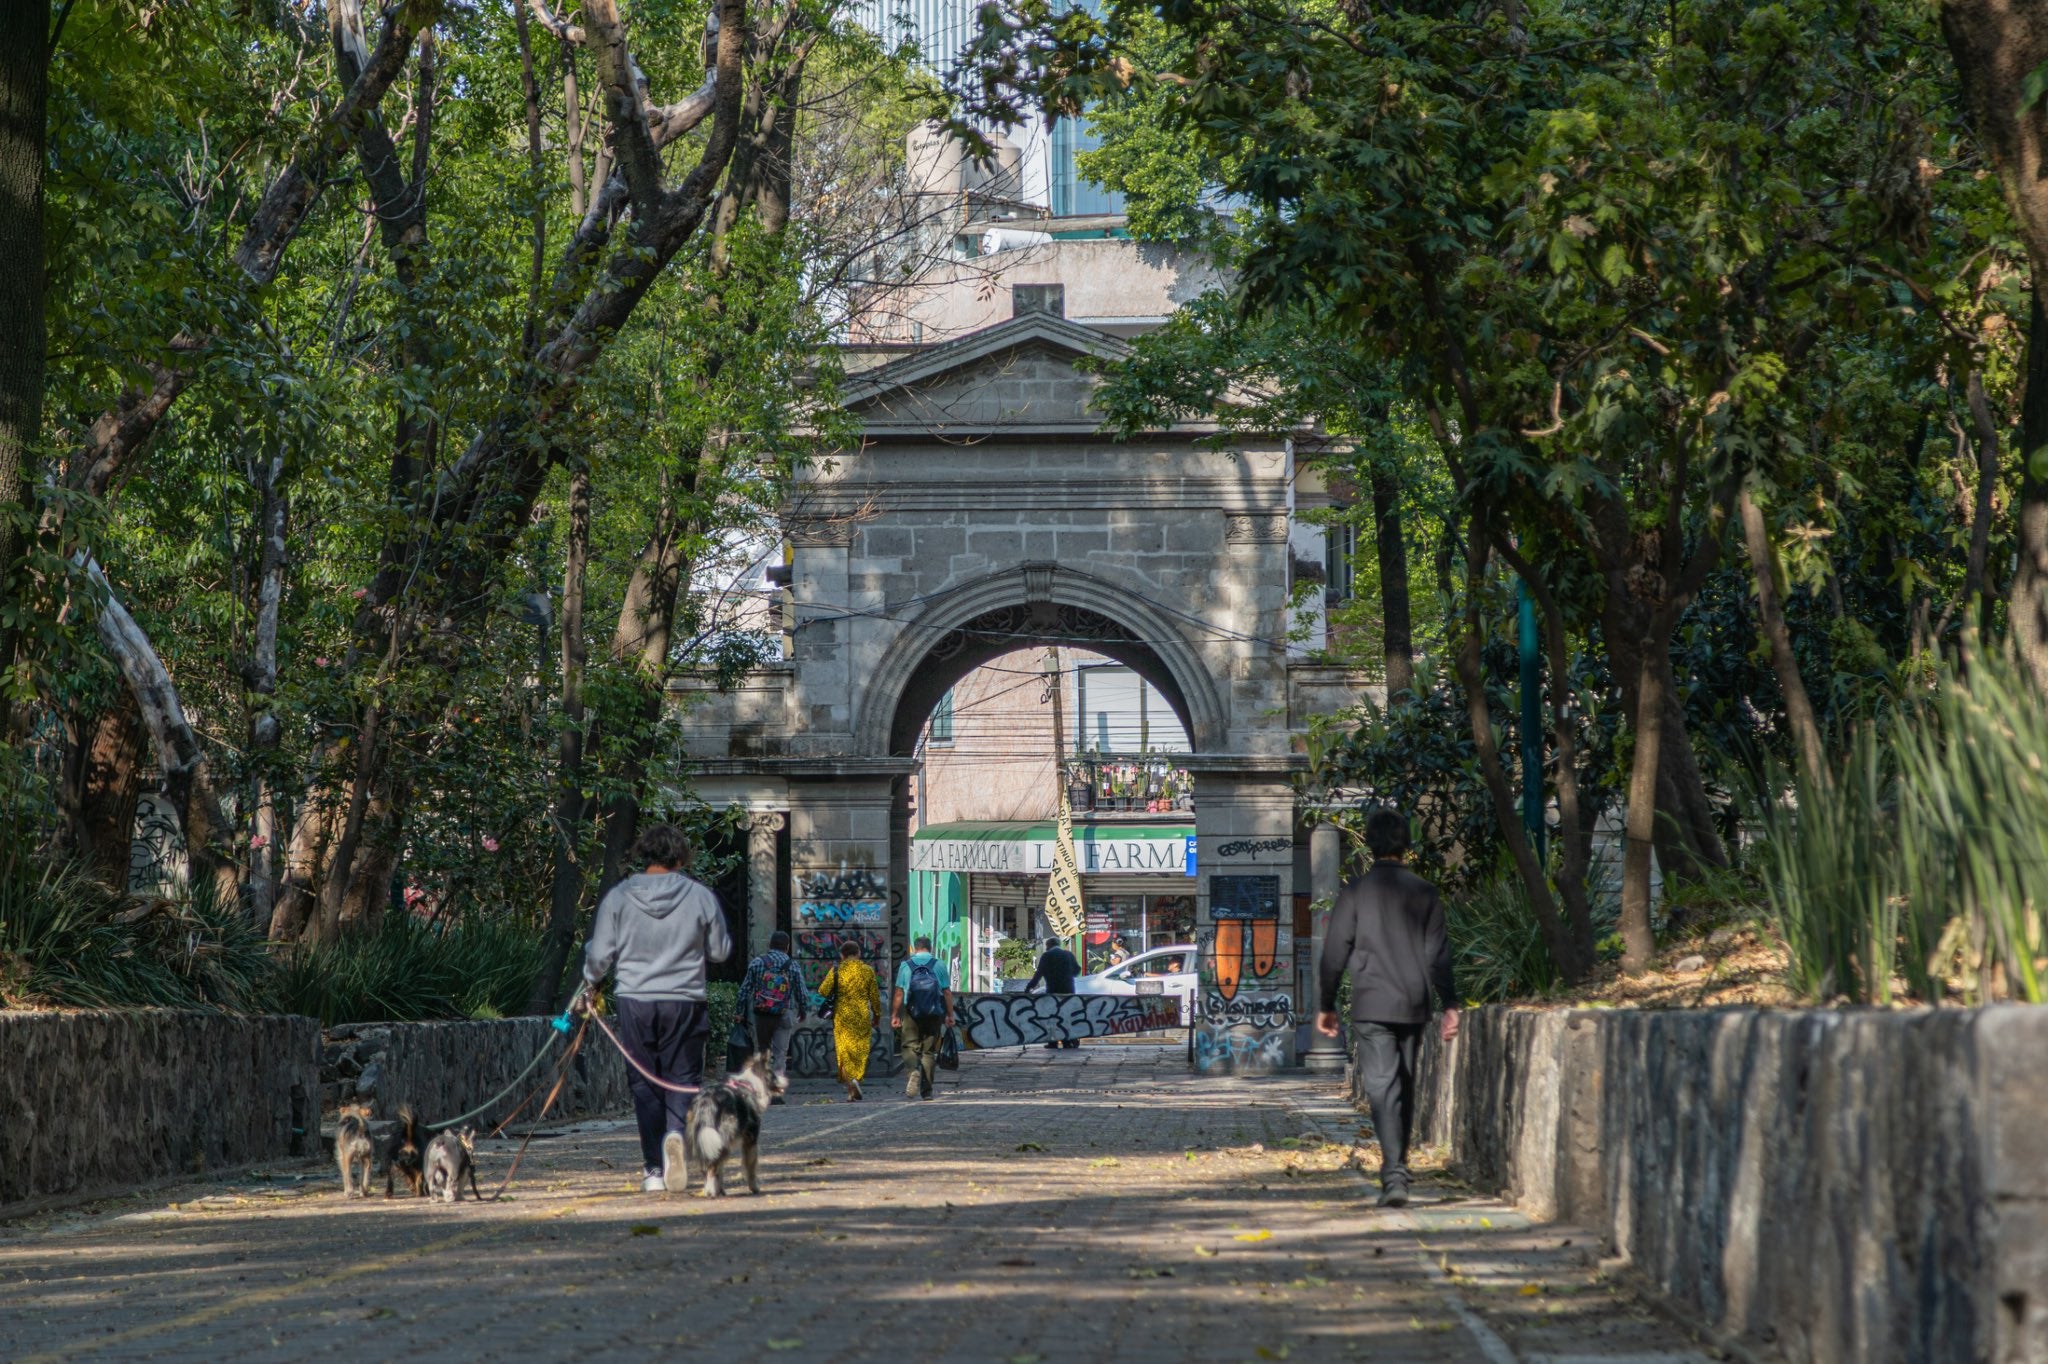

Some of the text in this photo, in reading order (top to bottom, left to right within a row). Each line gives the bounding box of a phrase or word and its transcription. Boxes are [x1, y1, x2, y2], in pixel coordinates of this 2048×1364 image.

[930, 843, 1008, 870] LA FARMACIA
[1056, 876, 1070, 895] EL
